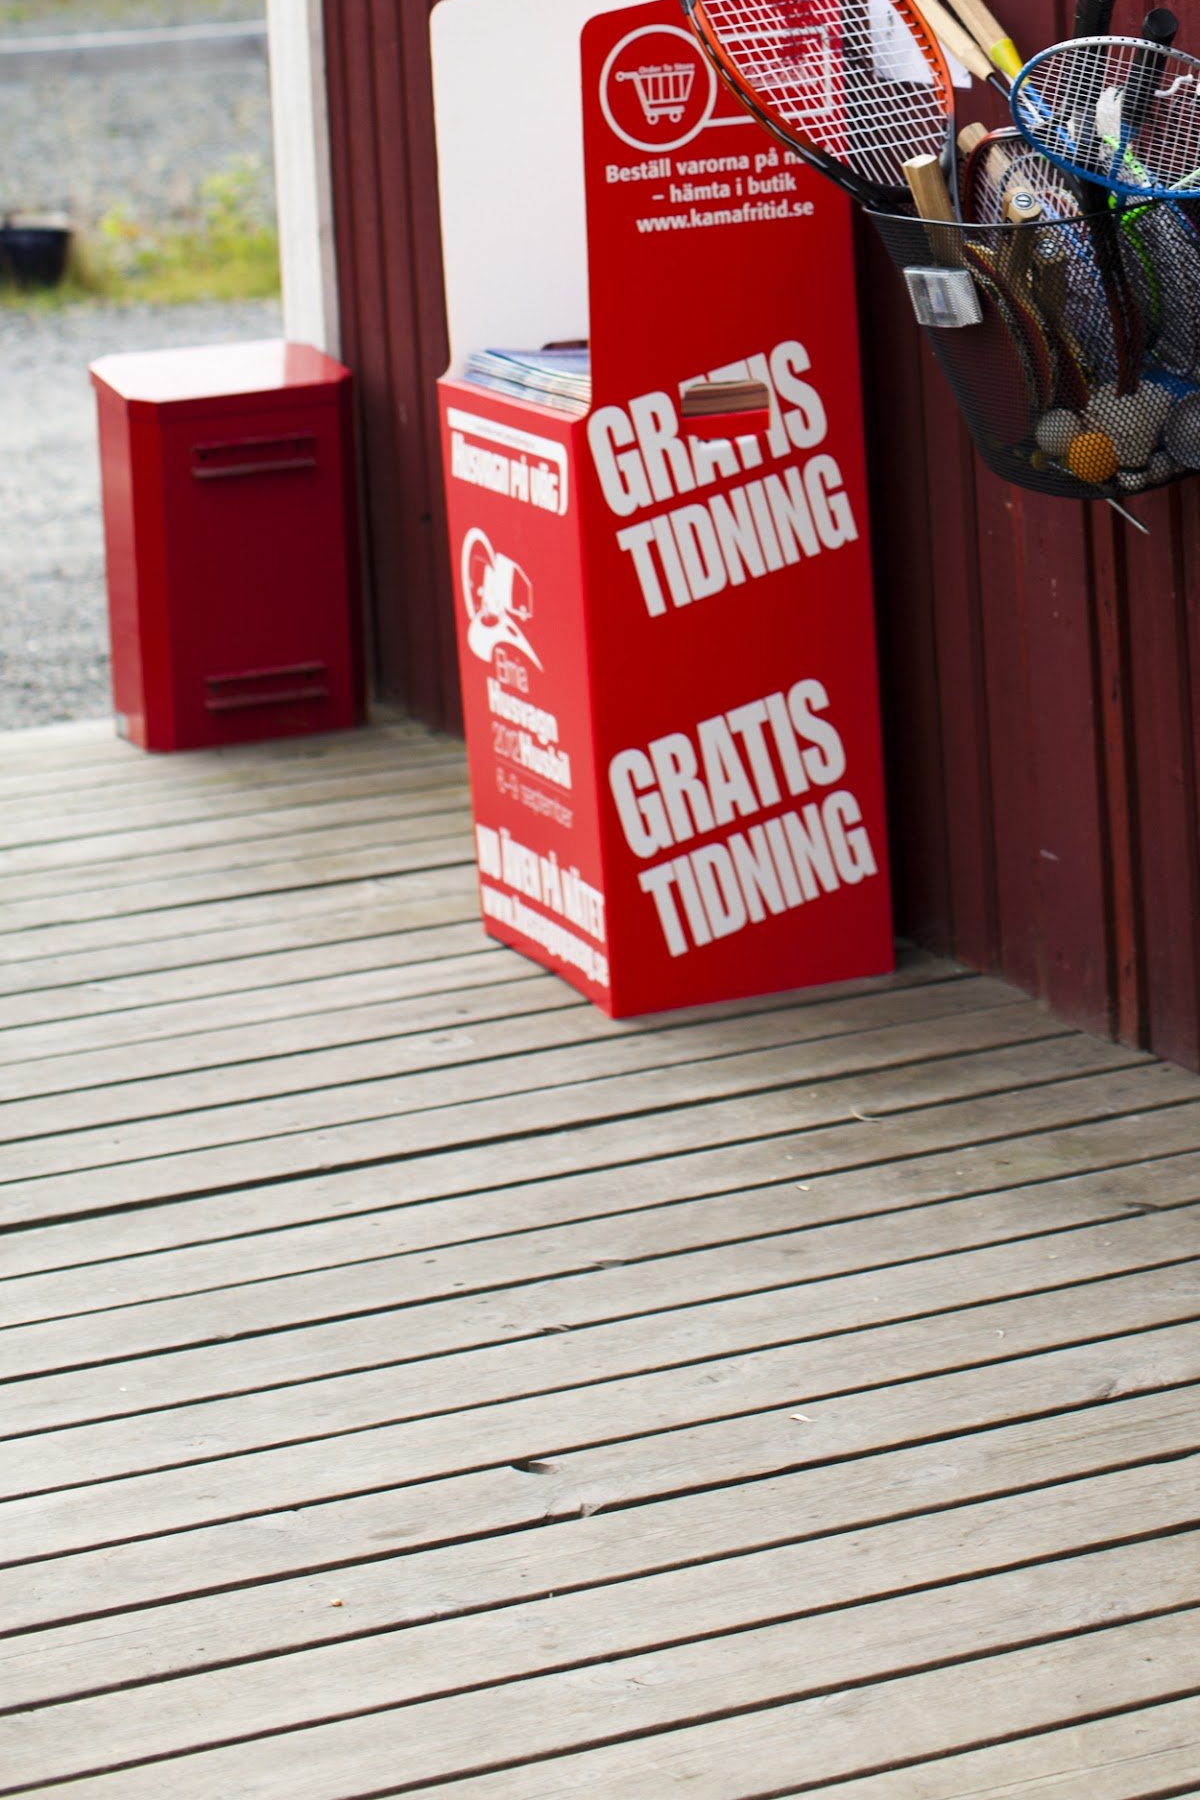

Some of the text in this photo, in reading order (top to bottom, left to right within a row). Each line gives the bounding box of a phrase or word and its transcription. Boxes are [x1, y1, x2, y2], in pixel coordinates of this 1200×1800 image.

[605, 158, 671, 183] Beställ
[676, 154, 750, 177] varorna
[755, 147, 779, 174] på
[636, 200, 815, 233] www.kamafritid.se
[669, 182, 731, 204] hämta
[735, 177, 743, 197] i
[747, 172, 797, 196] butik
[586, 340, 828, 517] GRATIS
[615, 454, 859, 618] TIDNING
[486, 676, 559, 746] Husvagn
[608, 678, 847, 860] GRATIS
[637, 790, 878, 958] TIDNING
